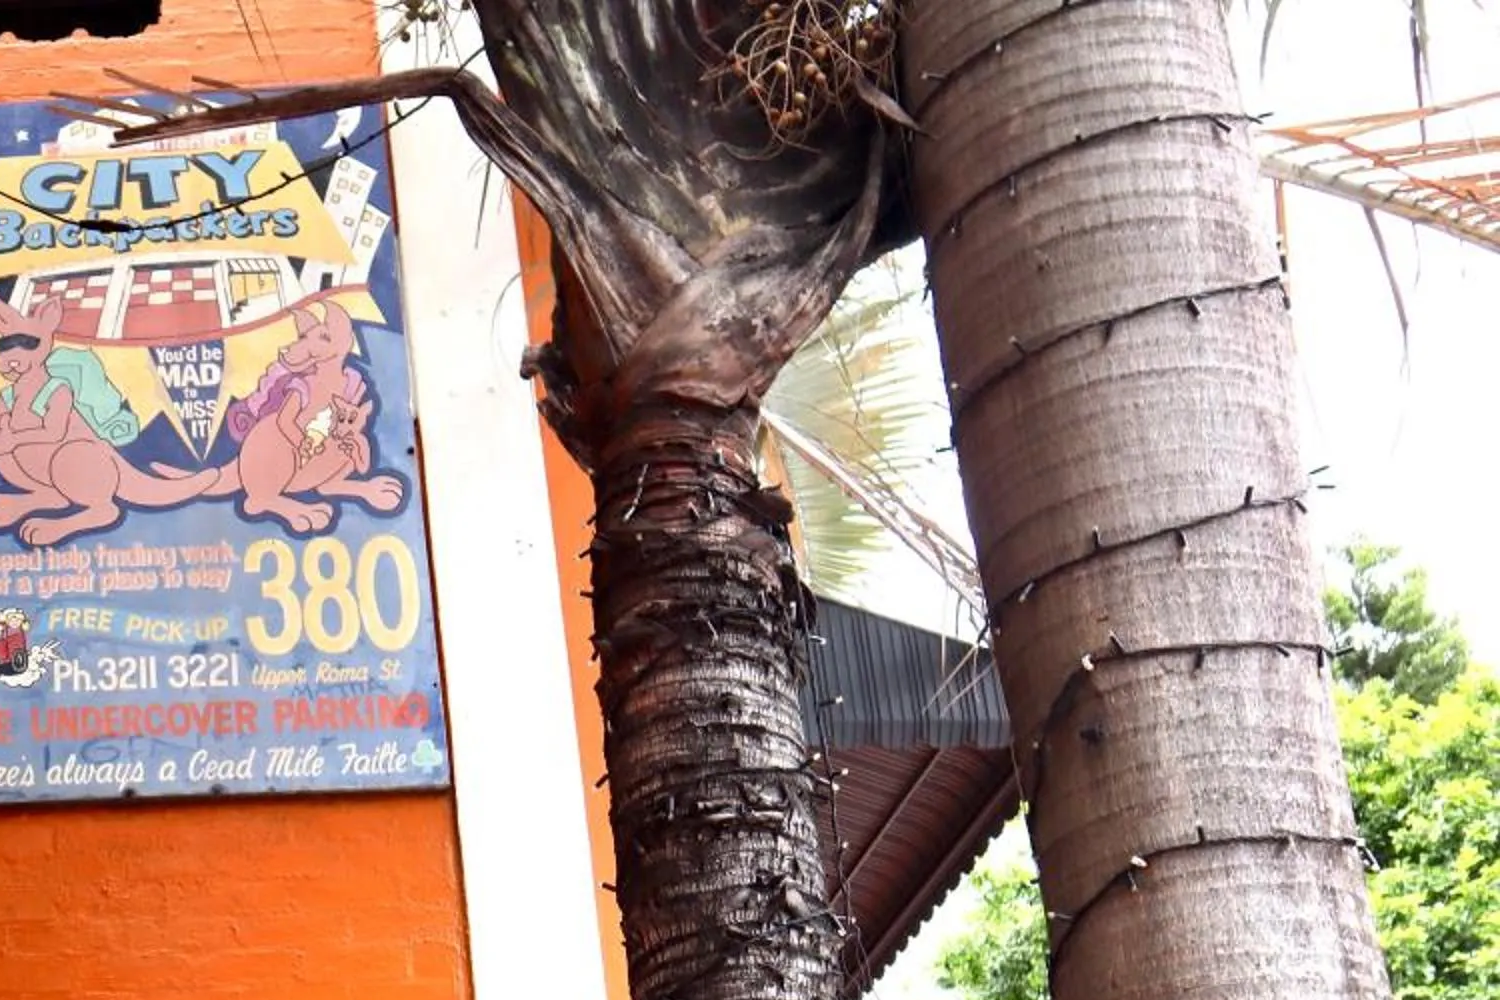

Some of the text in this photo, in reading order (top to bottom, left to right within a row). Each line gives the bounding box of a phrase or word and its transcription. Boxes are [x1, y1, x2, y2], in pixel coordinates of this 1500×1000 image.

[20, 150, 266, 213] CITY
[155, 343, 223, 363] You'd be
[156, 362, 221, 388] MAD
[173, 399, 218, 419] MISS
[183, 388, 198, 399] to
[47, 545, 92, 576] help
[94, 541, 177, 570] finding
[15, 575, 34, 596] a
[35, 569, 95, 599] great
[101, 568, 159, 597] place
[160, 567, 184, 588] to
[243, 533, 421, 656] 380
[48, 607, 230, 644] FREE PICK-UP
[167, 651, 240, 689] 3221
[315, 660, 369, 684] Roma
[30, 701, 259, 742] UNDERCOVER
[272, 691, 430, 735] PARKING
[46, 753, 145, 791] always
[158, 760, 179, 783] a
[187, 747, 257, 782] Cead
[265, 745, 325, 778] Mile
[337, 740, 408, 776] Failte
